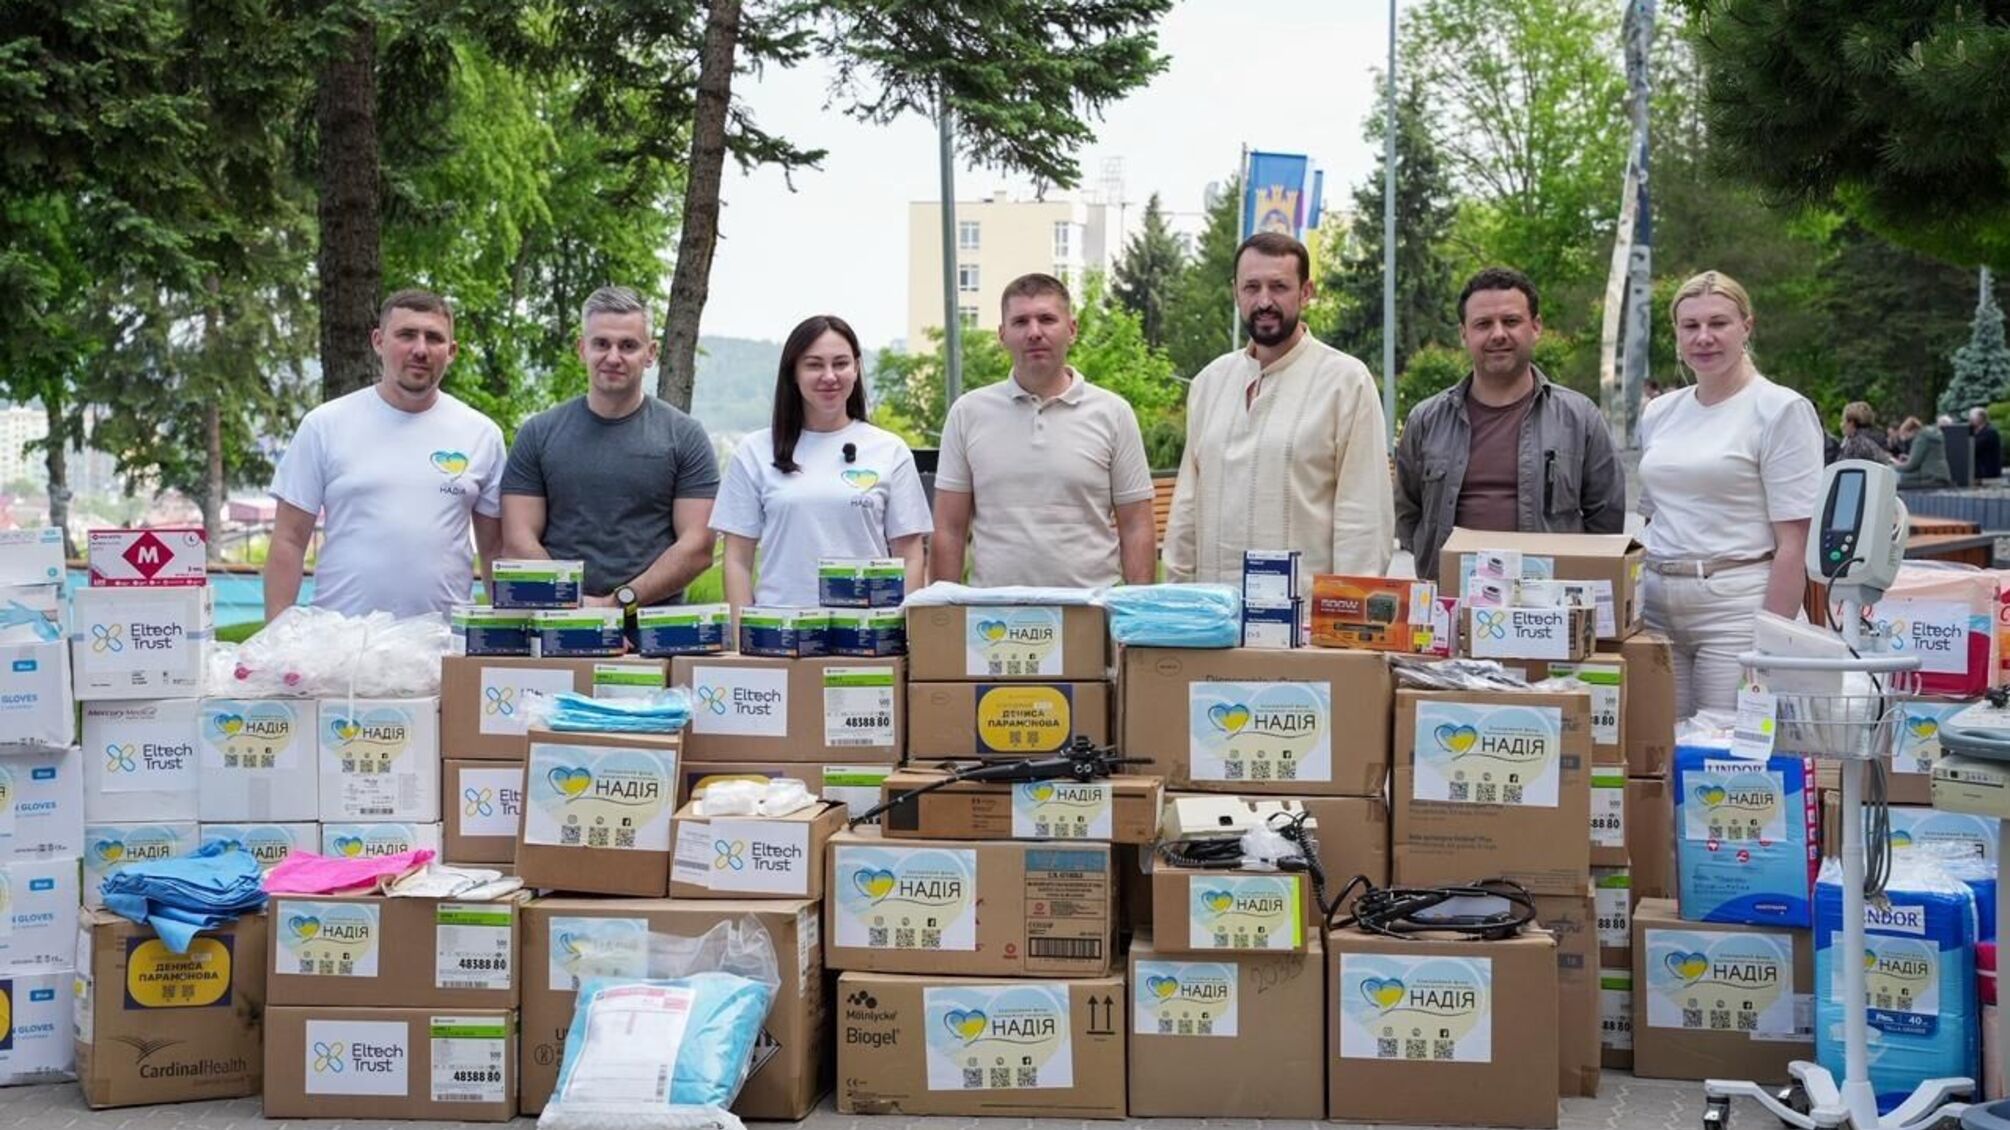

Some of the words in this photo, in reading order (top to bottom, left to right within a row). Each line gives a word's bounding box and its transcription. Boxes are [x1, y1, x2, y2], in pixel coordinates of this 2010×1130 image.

[137, 545, 160, 565] M
[1512, 611, 1563, 626] Eltech
[131, 622, 183, 638] Eltech
[1008, 628, 1054, 641] НАДІЯ
[1513, 626, 1553, 639] Trust
[1911, 621, 1962, 638] Eltech
[133, 637, 173, 650] Trust
[1912, 637, 1951, 650] Trust
[733, 687, 781, 703] Eltech
[734, 702, 772, 715] Trust
[246, 721, 289, 734] НАДІЯ
[877, 717, 890, 727] 80
[1254, 714, 1316, 731] НАДІЯ
[362, 727, 405, 740] НАДІЯ
[143, 743, 193, 757] Eltech
[1482, 735, 1545, 756] НАДІЯ
[144, 757, 183, 770] Trust
[595, 779, 659, 799] НАДІЯ
[1056, 788, 1102, 802] НАДІЯ
[1728, 793, 1775, 805] НАДІЯ
[126, 845, 170, 860] НАДІЯ
[752, 841, 802, 858] Eltech
[752, 857, 792, 872] Trust
[900, 880, 961, 899] НАДІЯ
[1236, 899, 1283, 912] НАДІЯ
[1864, 909, 1919, 927] NDOR
[322, 925, 369, 939] НАДІЯ
[1713, 963, 1777, 982] НАДІЯ
[1879, 959, 1929, 976] НАДІЯ
[139, 971, 219, 982] ПАРАМОНОВА
[1180, 984, 1228, 998] НАДІЯ
[1410, 989, 1476, 1009] НАДІЯ
[18, 1023, 55, 1034] GLOVES
[991, 1018, 1056, 1036] НАДІЯ
[846, 1026, 897, 1048] Biogel
[351, 1043, 404, 1058] Eltech
[139, 1058, 248, 1079] CardinalHealth
[353, 1058, 393, 1073] Trust
[487, 1071, 501, 1082] 80
